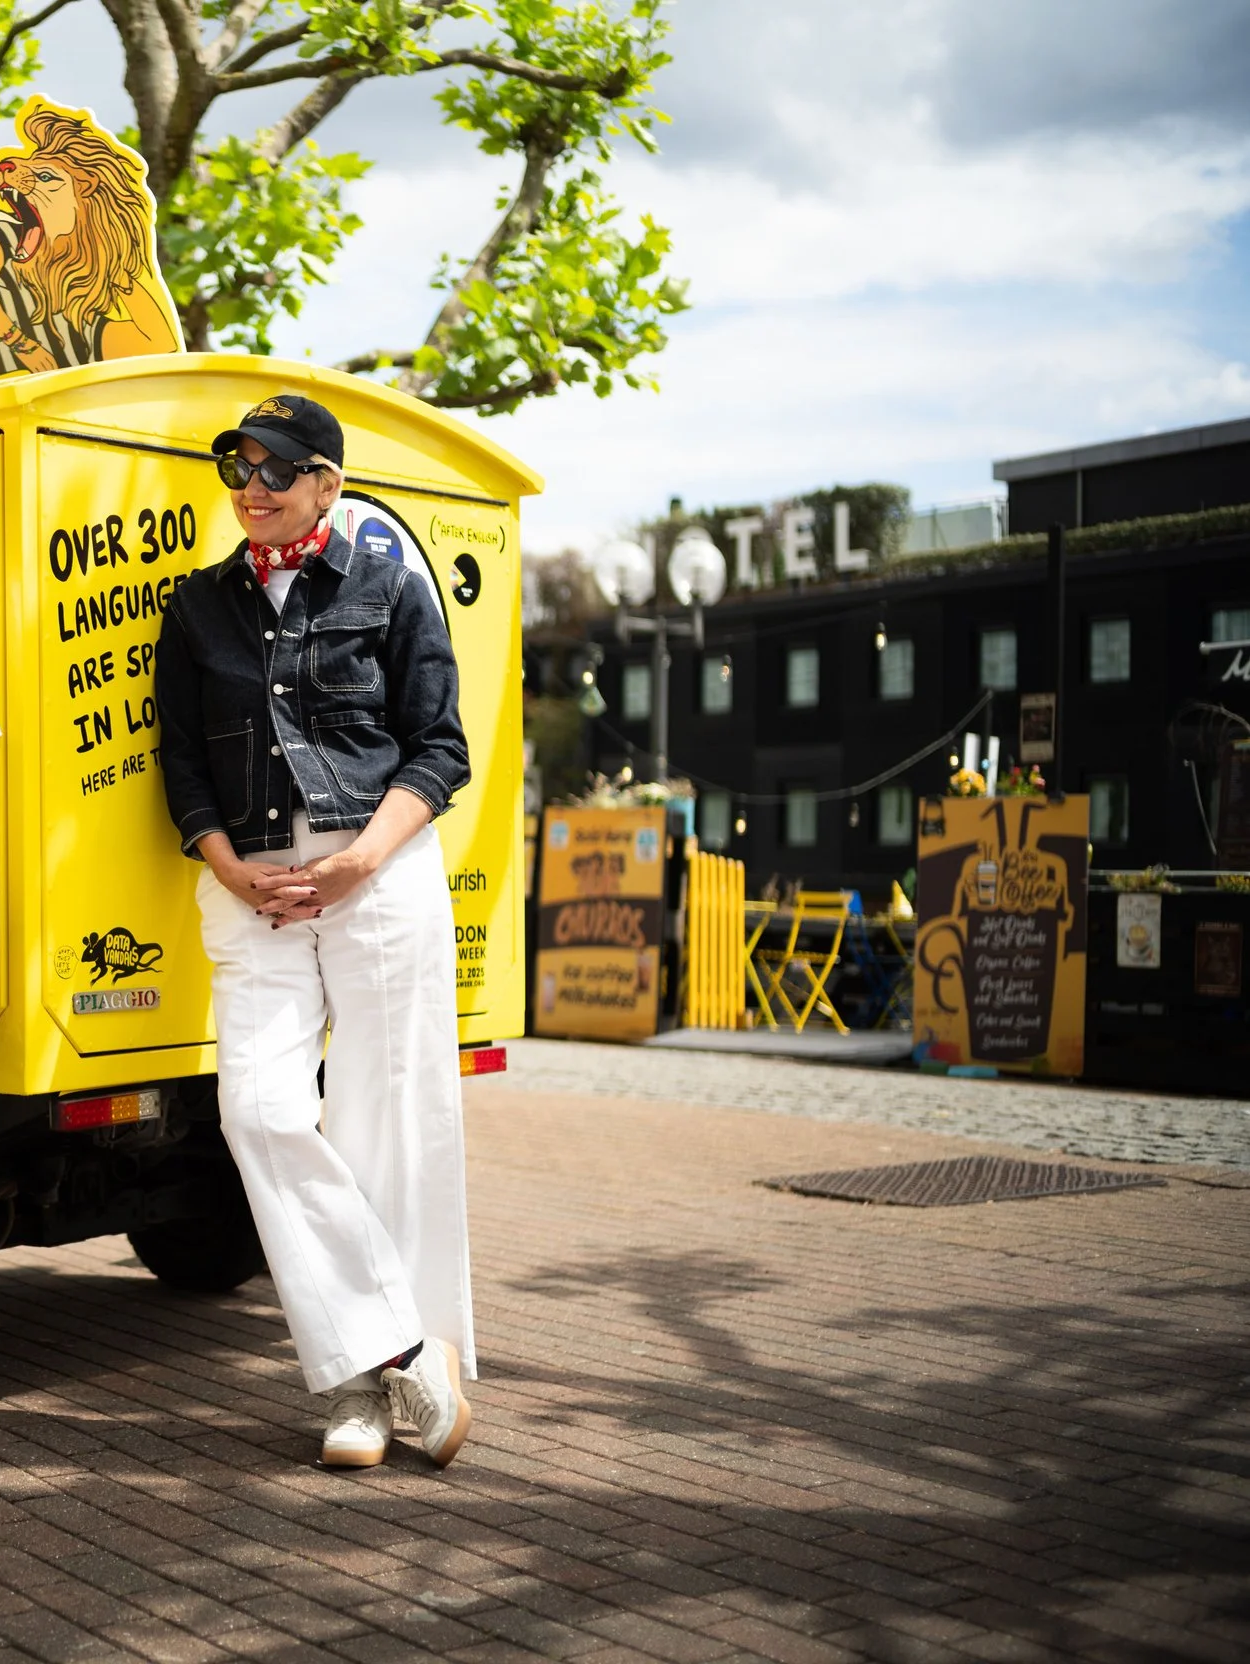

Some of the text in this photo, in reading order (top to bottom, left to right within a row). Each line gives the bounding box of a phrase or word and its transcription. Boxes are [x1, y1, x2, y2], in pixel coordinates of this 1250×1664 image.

[50, 503, 196, 582] OVER 300
[68, 651, 114, 699] ARE
[74, 705, 112, 753] IN
[81, 765, 116, 796] HERE
[122, 753, 146, 779] ARE
[448, 868, 486, 891] urish
[106, 934, 130, 951] DATA
[455, 925, 486, 943] DON
[104, 946, 139, 966] VANDALS
[458, 947, 486, 960] WEEK
[467, 967, 484, 978] 2025
[79, 990, 156, 1011] PIAGGIO
